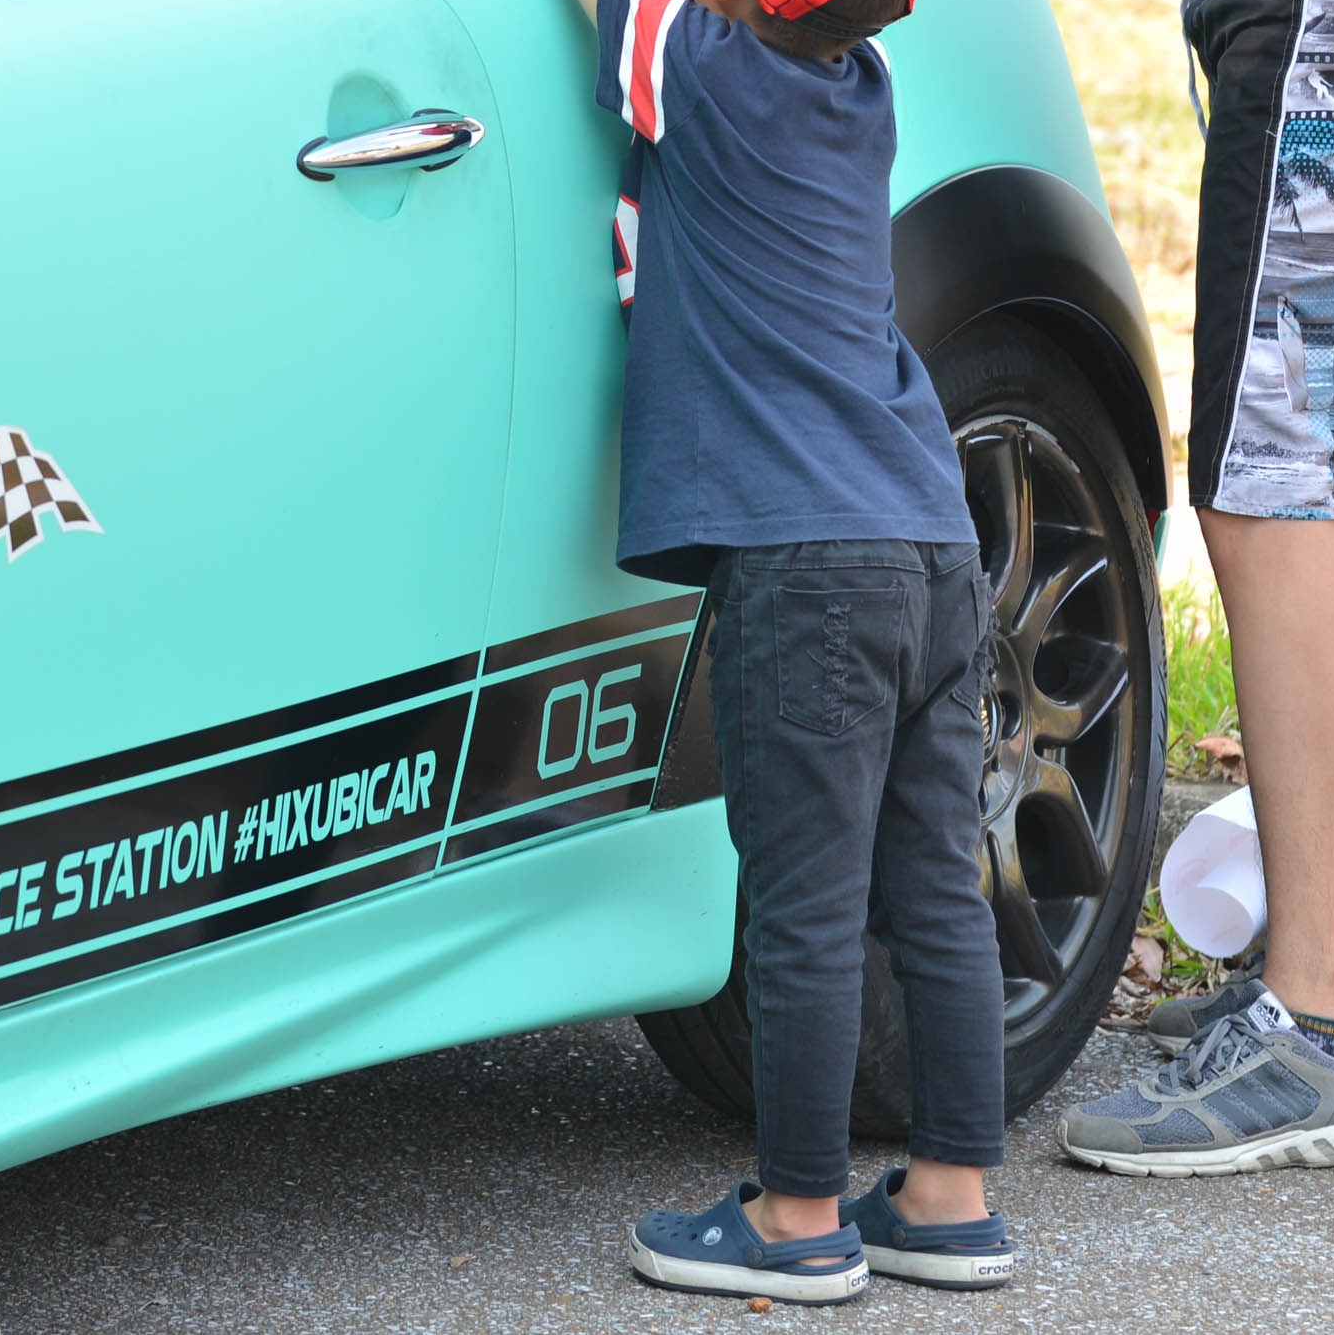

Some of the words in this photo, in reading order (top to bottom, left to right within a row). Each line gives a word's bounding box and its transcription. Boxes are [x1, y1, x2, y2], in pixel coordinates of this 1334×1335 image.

[537, 663, 642, 780] 06
[52, 809, 229, 921] STATION
[233, 749, 437, 864] #HIXUBICAR
